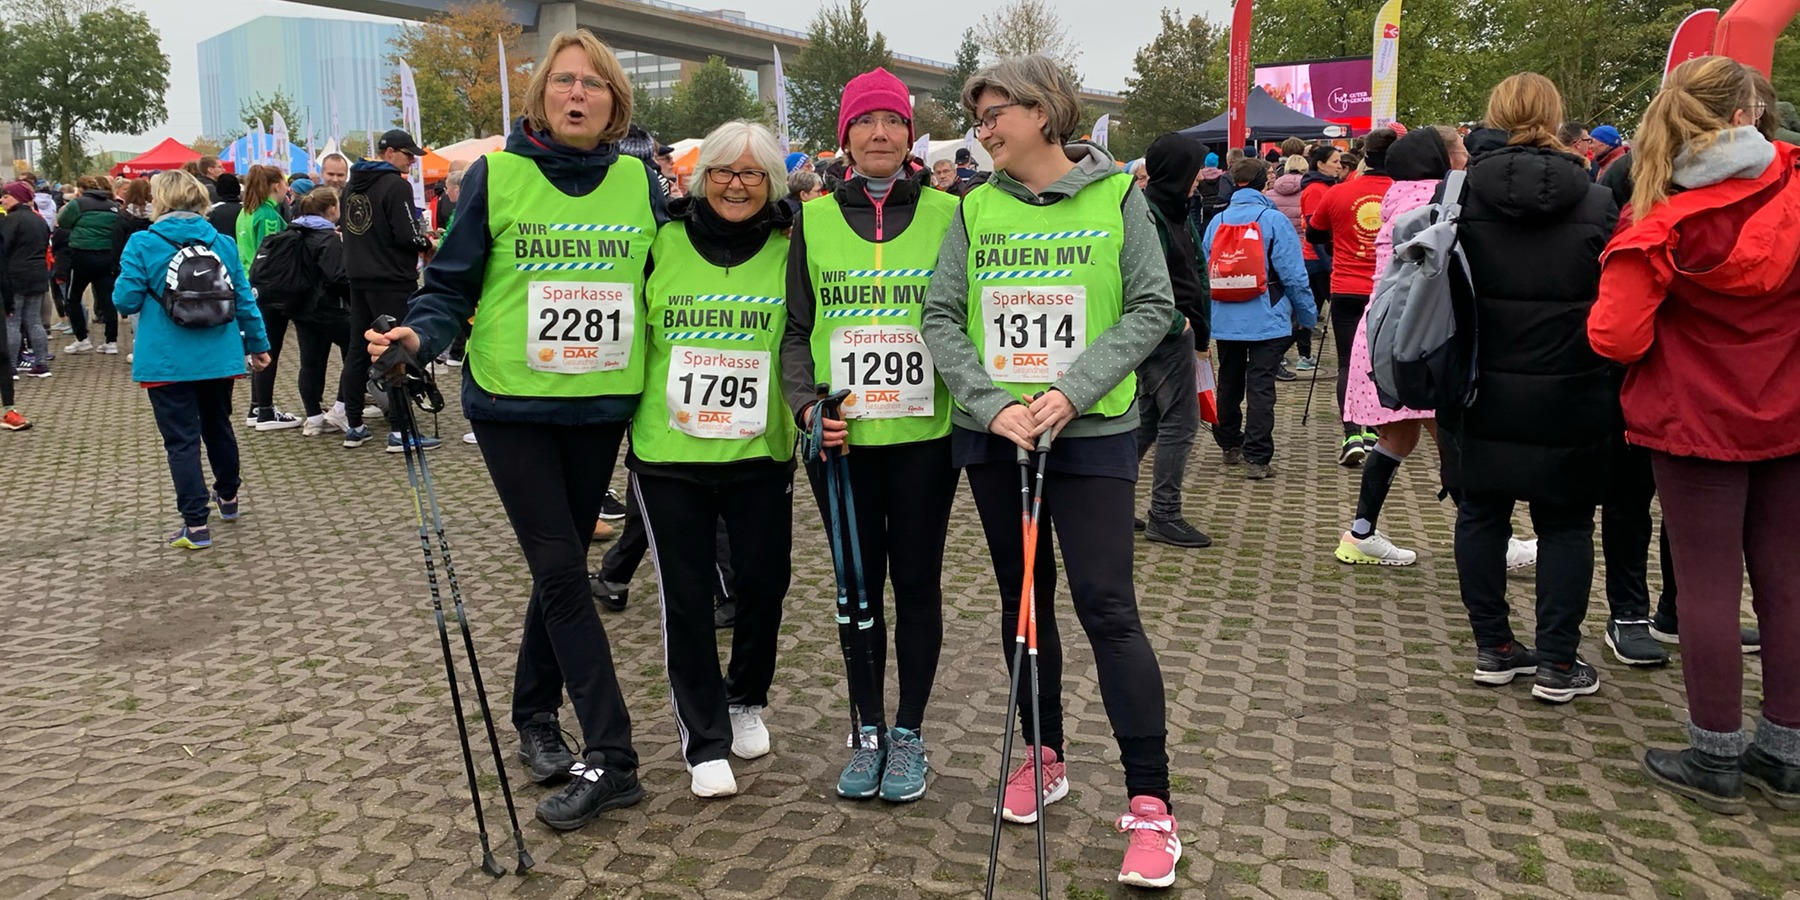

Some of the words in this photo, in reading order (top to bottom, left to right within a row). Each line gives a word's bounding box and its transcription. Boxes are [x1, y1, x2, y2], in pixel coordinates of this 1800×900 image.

[518, 223, 547, 235] WIR
[980, 234, 1006, 245] WIR
[515, 239, 592, 258] BAUEN
[598, 240, 635, 259] MV.
[976, 247, 1049, 269] BAUEN
[1056, 245, 1096, 265] MV.
[822, 271, 847, 284] WIR
[542, 286, 623, 302] Sparkasse
[668, 295, 694, 306] WIR
[820, 285, 886, 306] BAUEN
[992, 290, 1074, 308] Sparkasse
[539, 308, 620, 342] 2281
[664, 309, 734, 328] BAUEN
[740, 310, 774, 332] MV.
[994, 314, 1075, 348] 1314
[563, 346, 599, 358] DAK
[684, 350, 760, 369] Sparkasse
[1012, 354, 1048, 366] DAK
[842, 352, 924, 385] 1298
[679, 372, 758, 409] 1795
[865, 390, 900, 402] DAK
[698, 410, 732, 424] DAK
